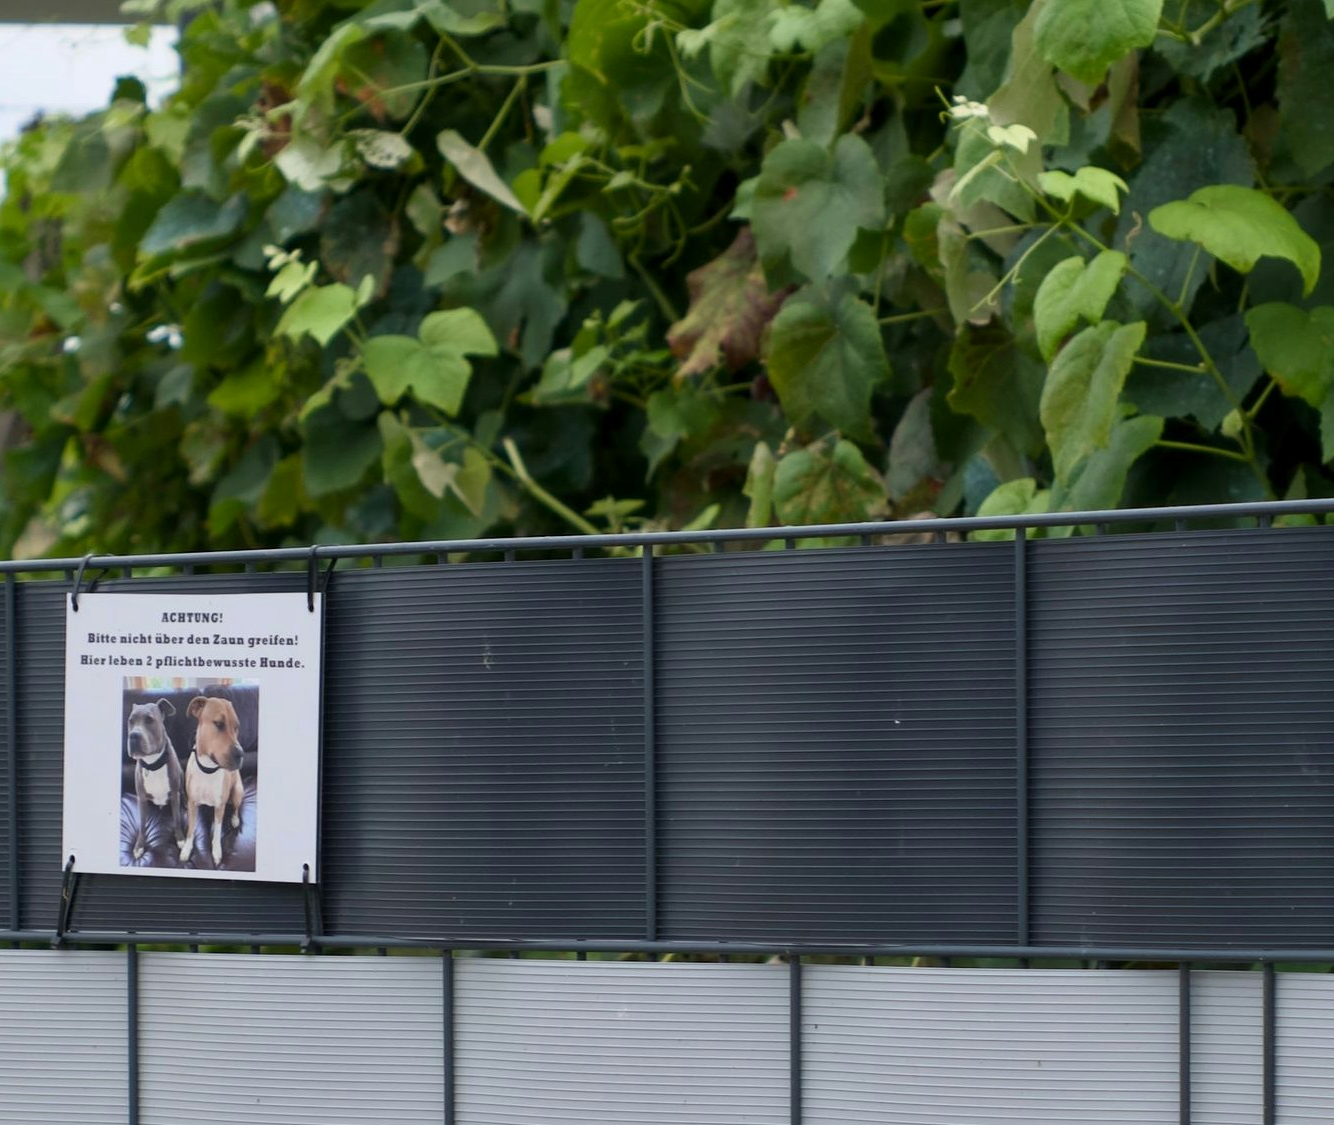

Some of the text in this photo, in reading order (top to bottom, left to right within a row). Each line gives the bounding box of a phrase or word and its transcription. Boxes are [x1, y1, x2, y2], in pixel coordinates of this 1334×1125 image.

[162, 612, 223, 623] ACHTUNG!
[88, 633, 298, 647] Bitte nicht über den Zaun greifen!
[80, 655, 305, 668] Hier leben 2 pflichtbewusste Hunde.
